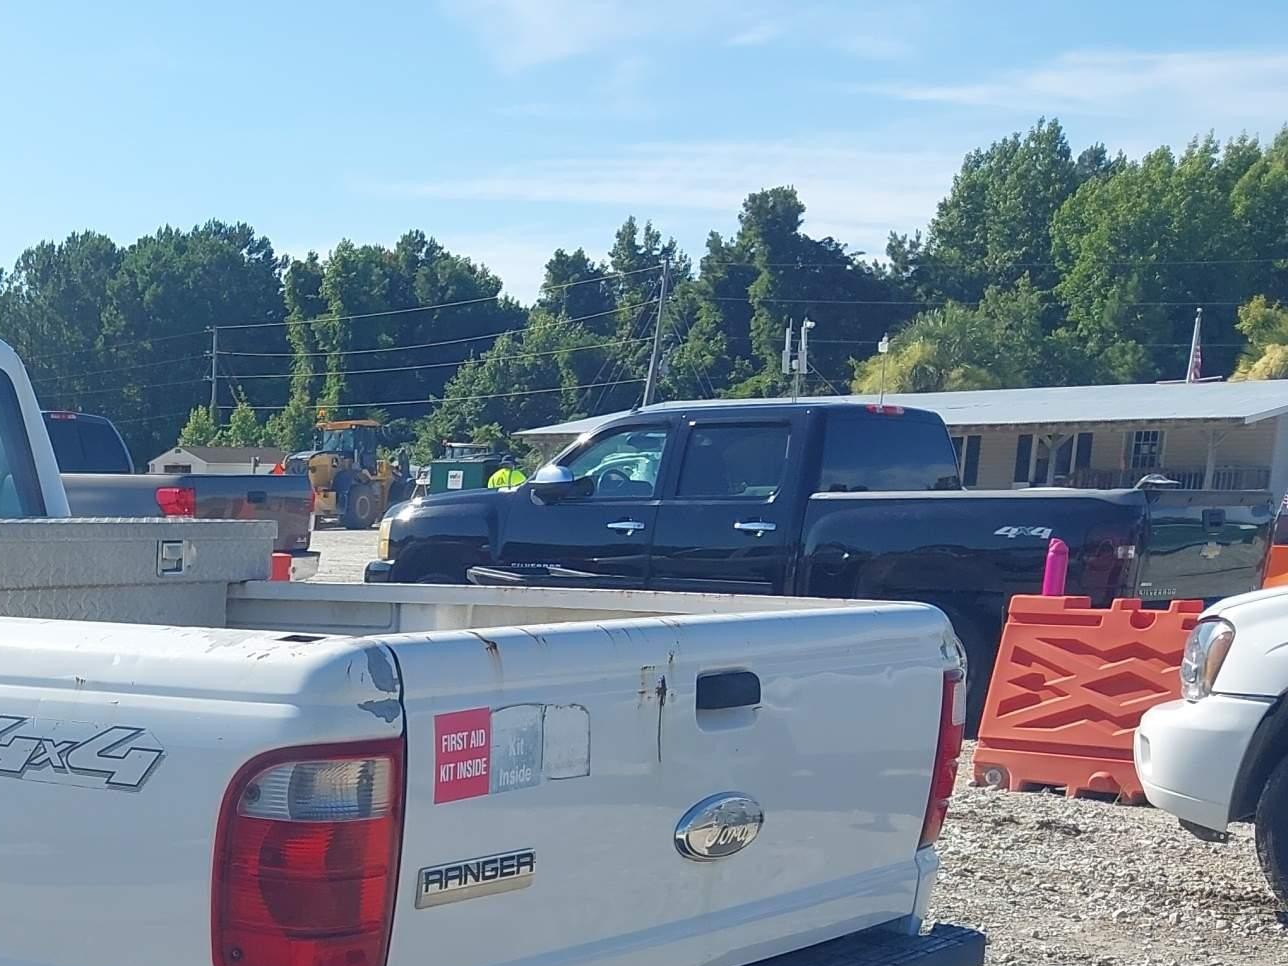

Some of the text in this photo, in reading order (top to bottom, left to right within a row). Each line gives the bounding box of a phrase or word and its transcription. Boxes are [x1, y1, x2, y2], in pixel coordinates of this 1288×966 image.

[441, 729, 486, 753] FIRST AID
[508, 737, 524, 756] Kit
[439, 757, 488, 783] KIT INSIDE
[498, 766, 532, 787] Inside
[423, 852, 535, 893] RANGER
